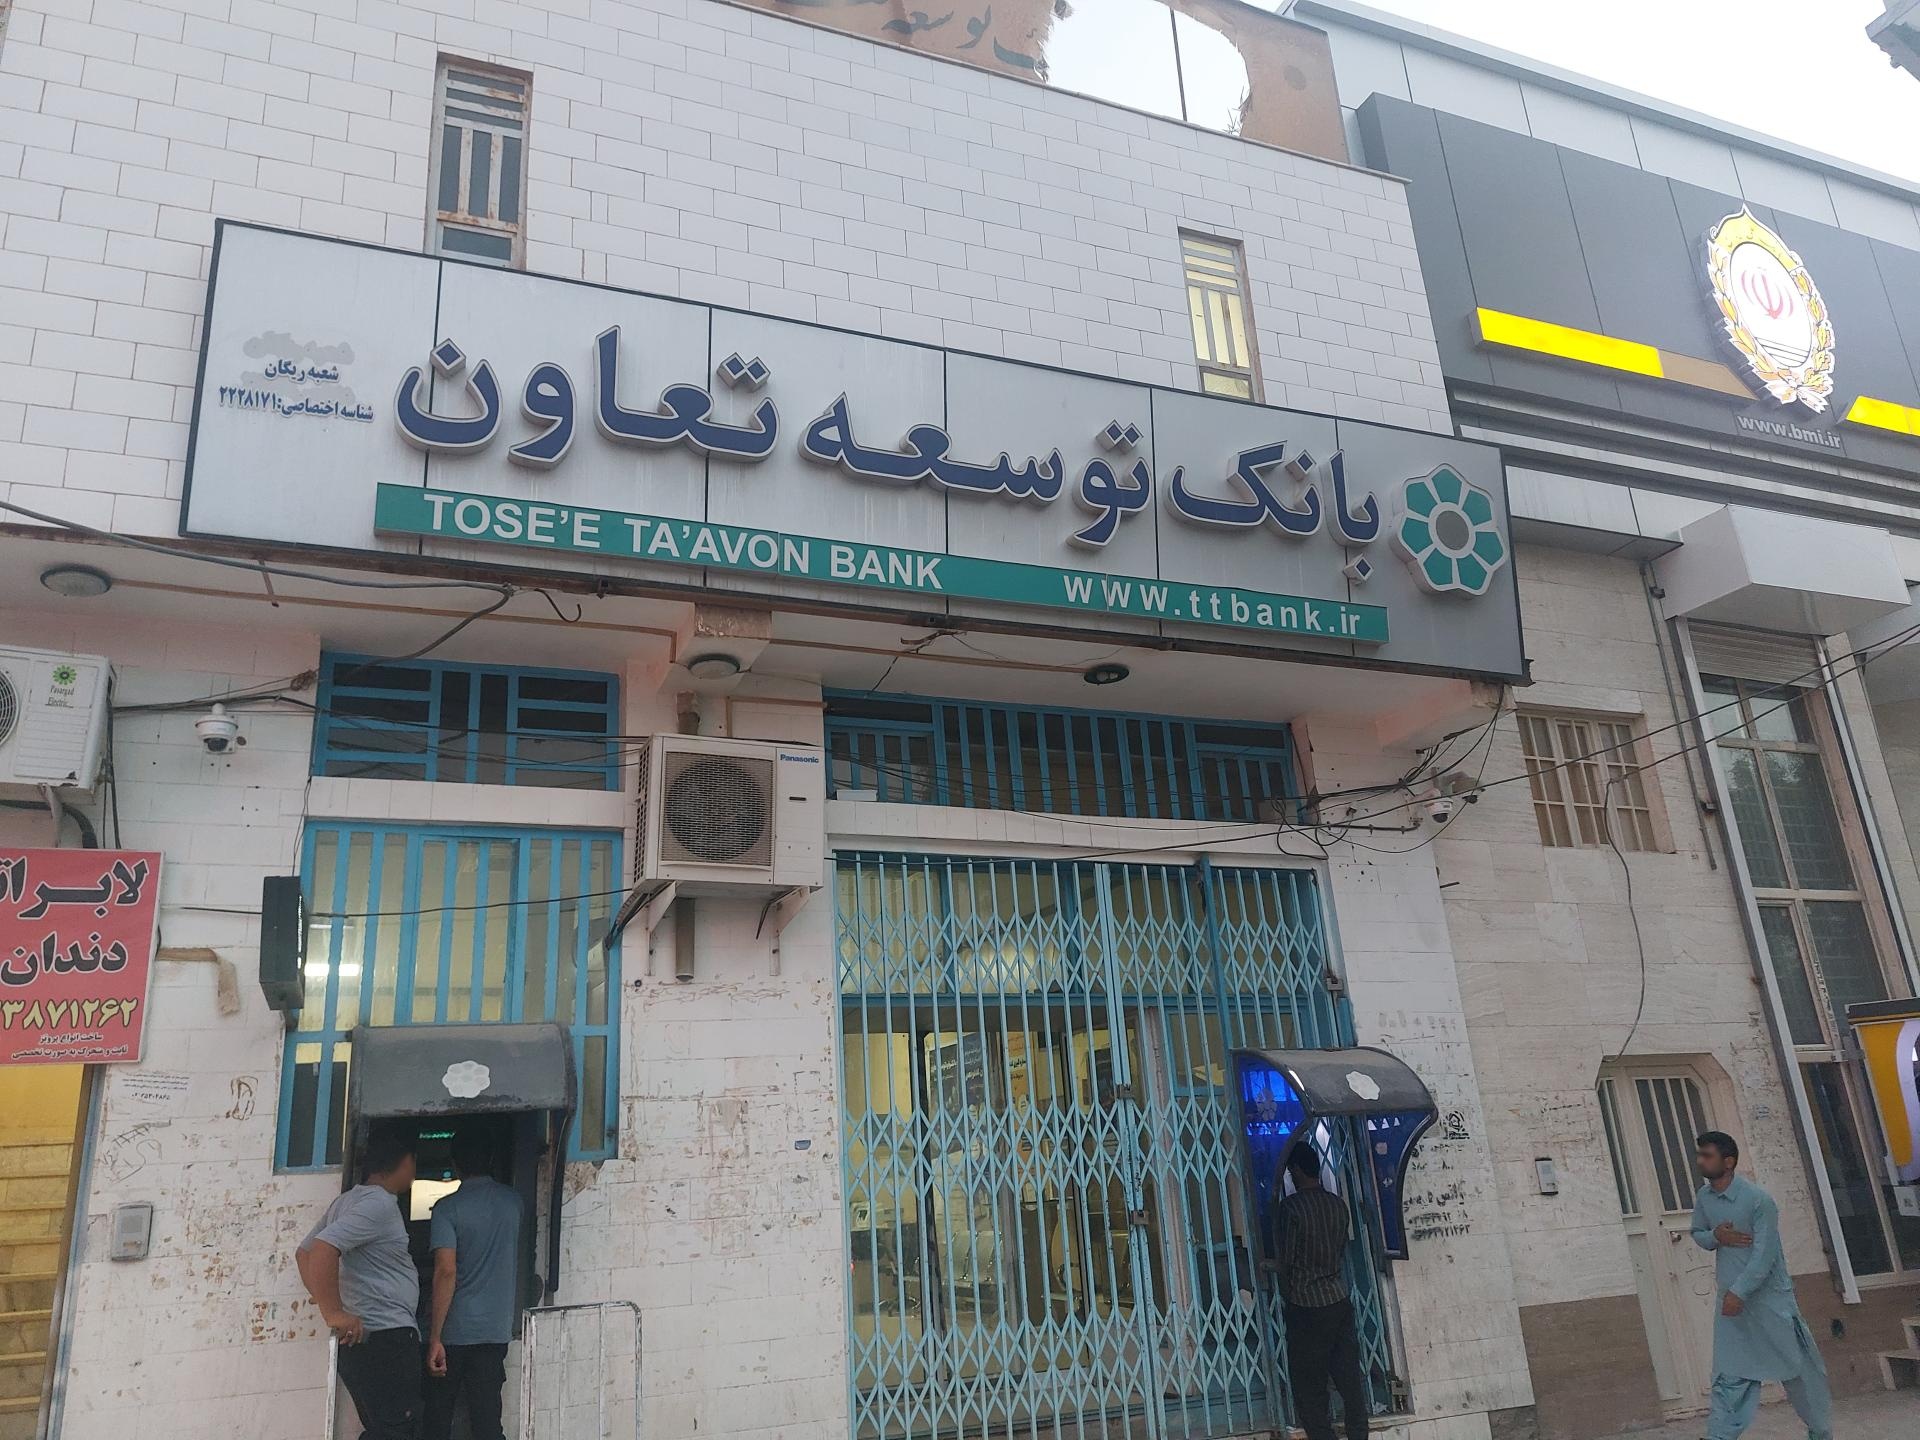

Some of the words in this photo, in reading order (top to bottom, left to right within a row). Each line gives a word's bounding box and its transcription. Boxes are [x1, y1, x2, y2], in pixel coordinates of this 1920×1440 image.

[264, 359, 306, 382] ریگان
[308, 365, 340, 384] شعبه
[341, 403, 375, 421] شناسه
[395, 325, 779, 468] تعاون
[1737, 415, 1841, 449] www.bmi.ir
[801, 391, 1150, 548] توسعه
[1166, 440, 1381, 584] بانک
[424, 494, 601, 549] TOSE'E
[624, 519, 810, 576] TA'AVON
[830, 543, 943, 590] BANK
[780, 753, 820, 764] Panasonic
[0, 931, 128, 987] دندان
